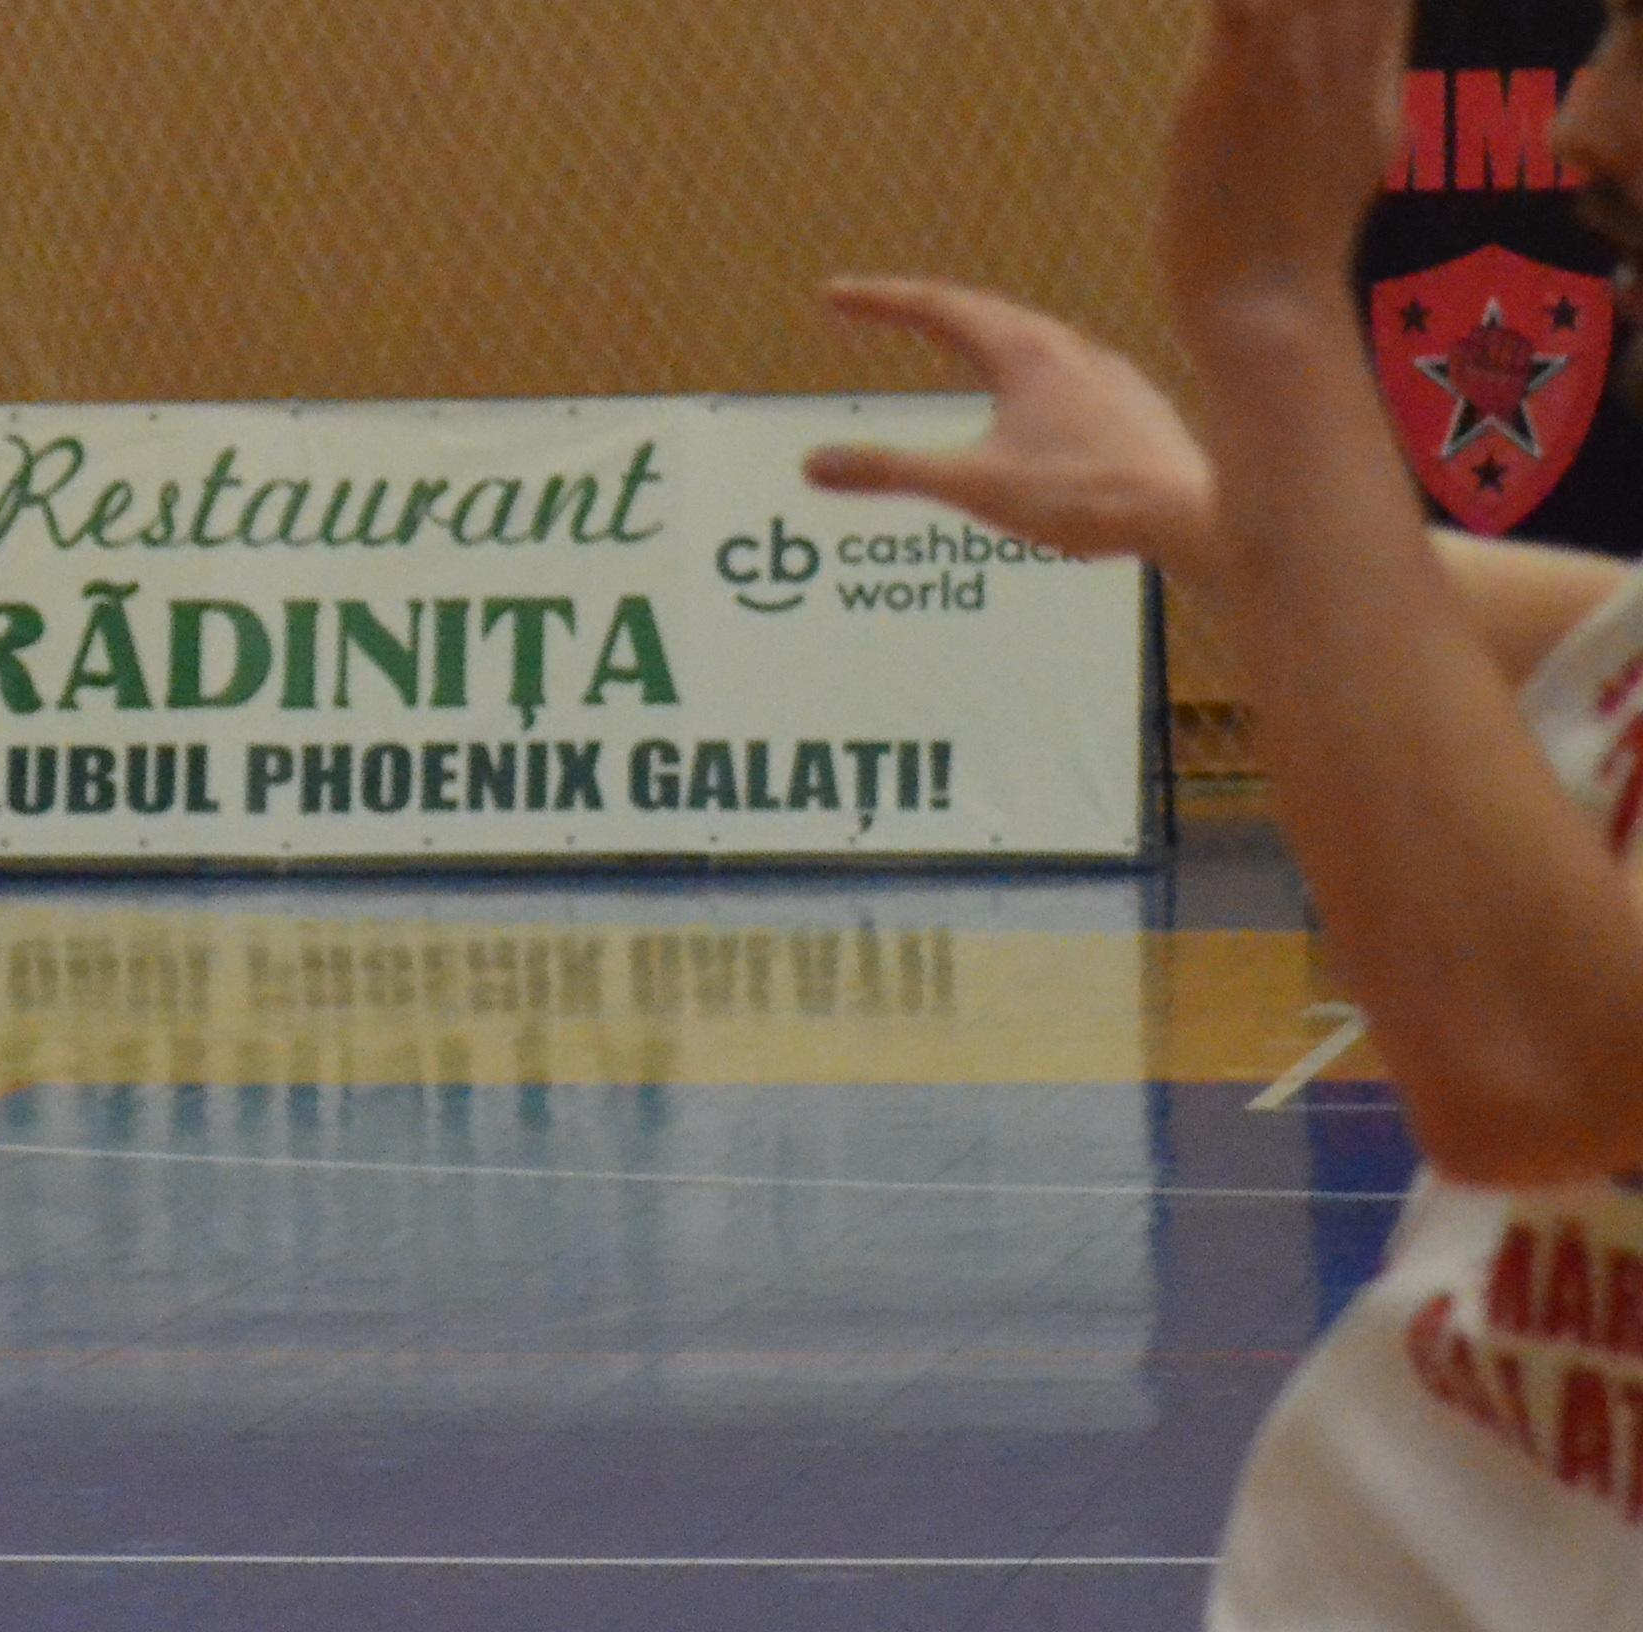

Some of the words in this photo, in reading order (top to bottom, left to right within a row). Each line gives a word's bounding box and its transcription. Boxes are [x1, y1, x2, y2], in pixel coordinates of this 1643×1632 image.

[835, 571, 987, 612] world
[244, 739, 605, 815] PHOENIX
[627, 737, 954, 834] GALAȚI!
